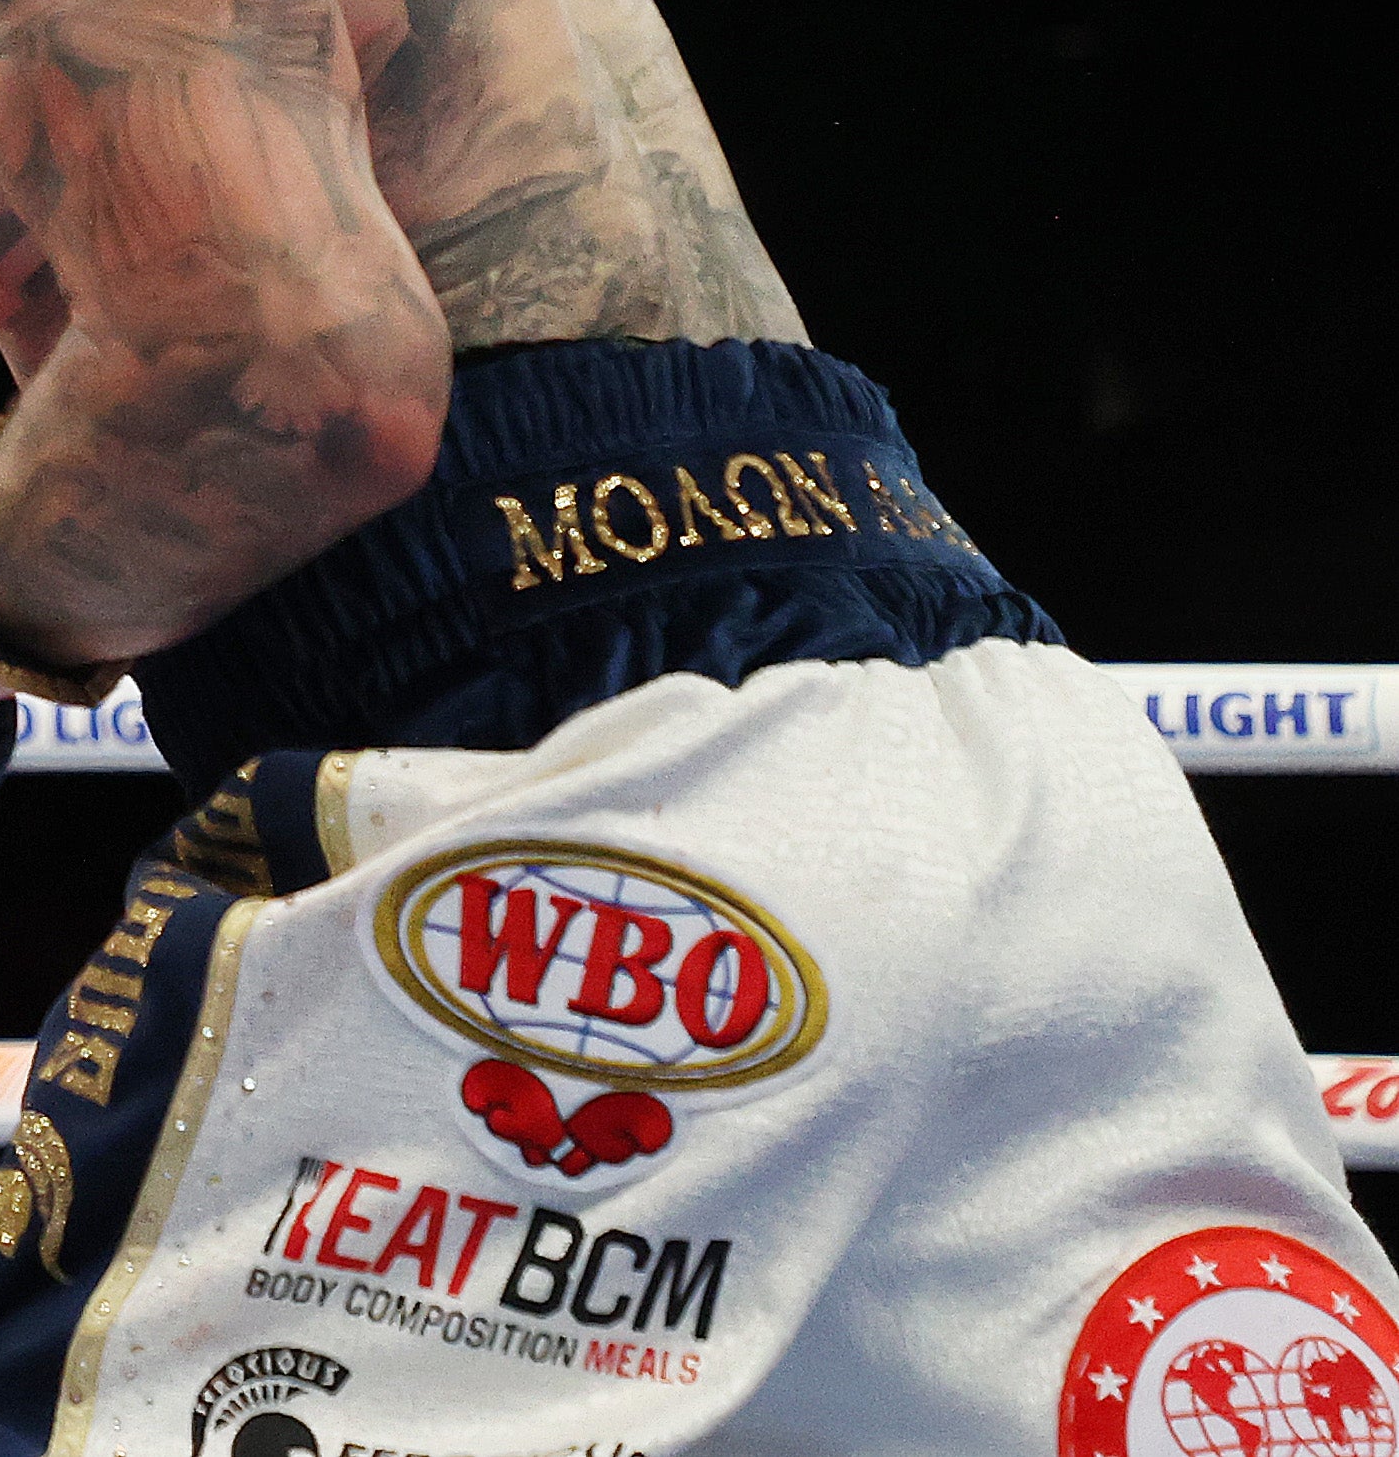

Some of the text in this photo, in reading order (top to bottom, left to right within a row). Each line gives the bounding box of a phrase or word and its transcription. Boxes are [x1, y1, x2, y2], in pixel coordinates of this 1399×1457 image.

[1146, 692, 1355, 740] LIGHT
[455, 872, 770, 1049] WBO
[246, 1267, 703, 1386] BODY COMPOSITION MEALS
[499, 1205, 733, 1341] BCM
